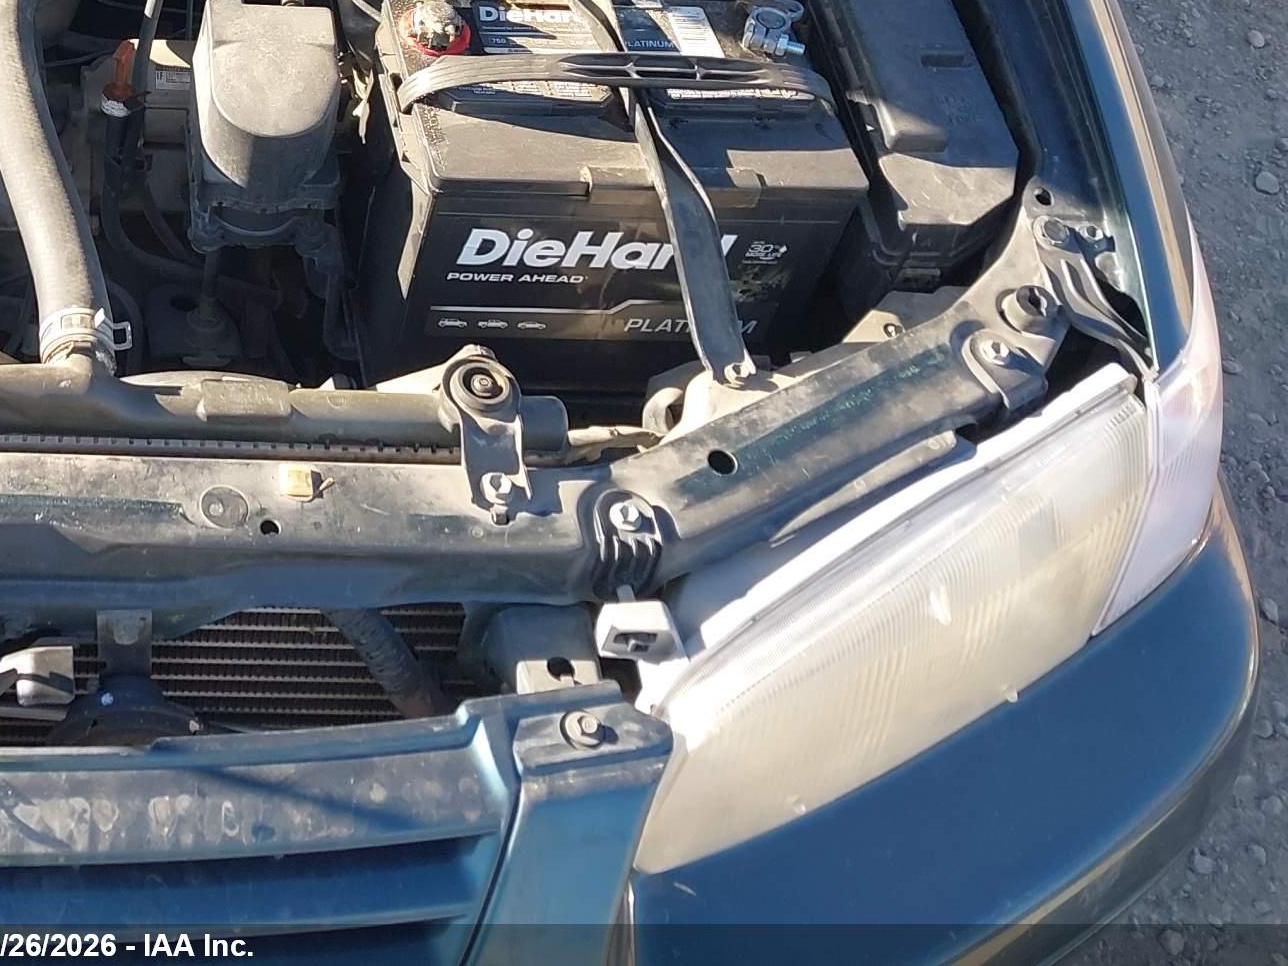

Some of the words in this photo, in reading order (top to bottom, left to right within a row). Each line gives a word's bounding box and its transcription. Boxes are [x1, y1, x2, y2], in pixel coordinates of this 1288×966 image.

[625, 40, 675, 48] LATINUM
[456, 228, 738, 270] DieHar
[446, 272, 514, 283] POWER
[518, 274, 585, 284] AHEAD
